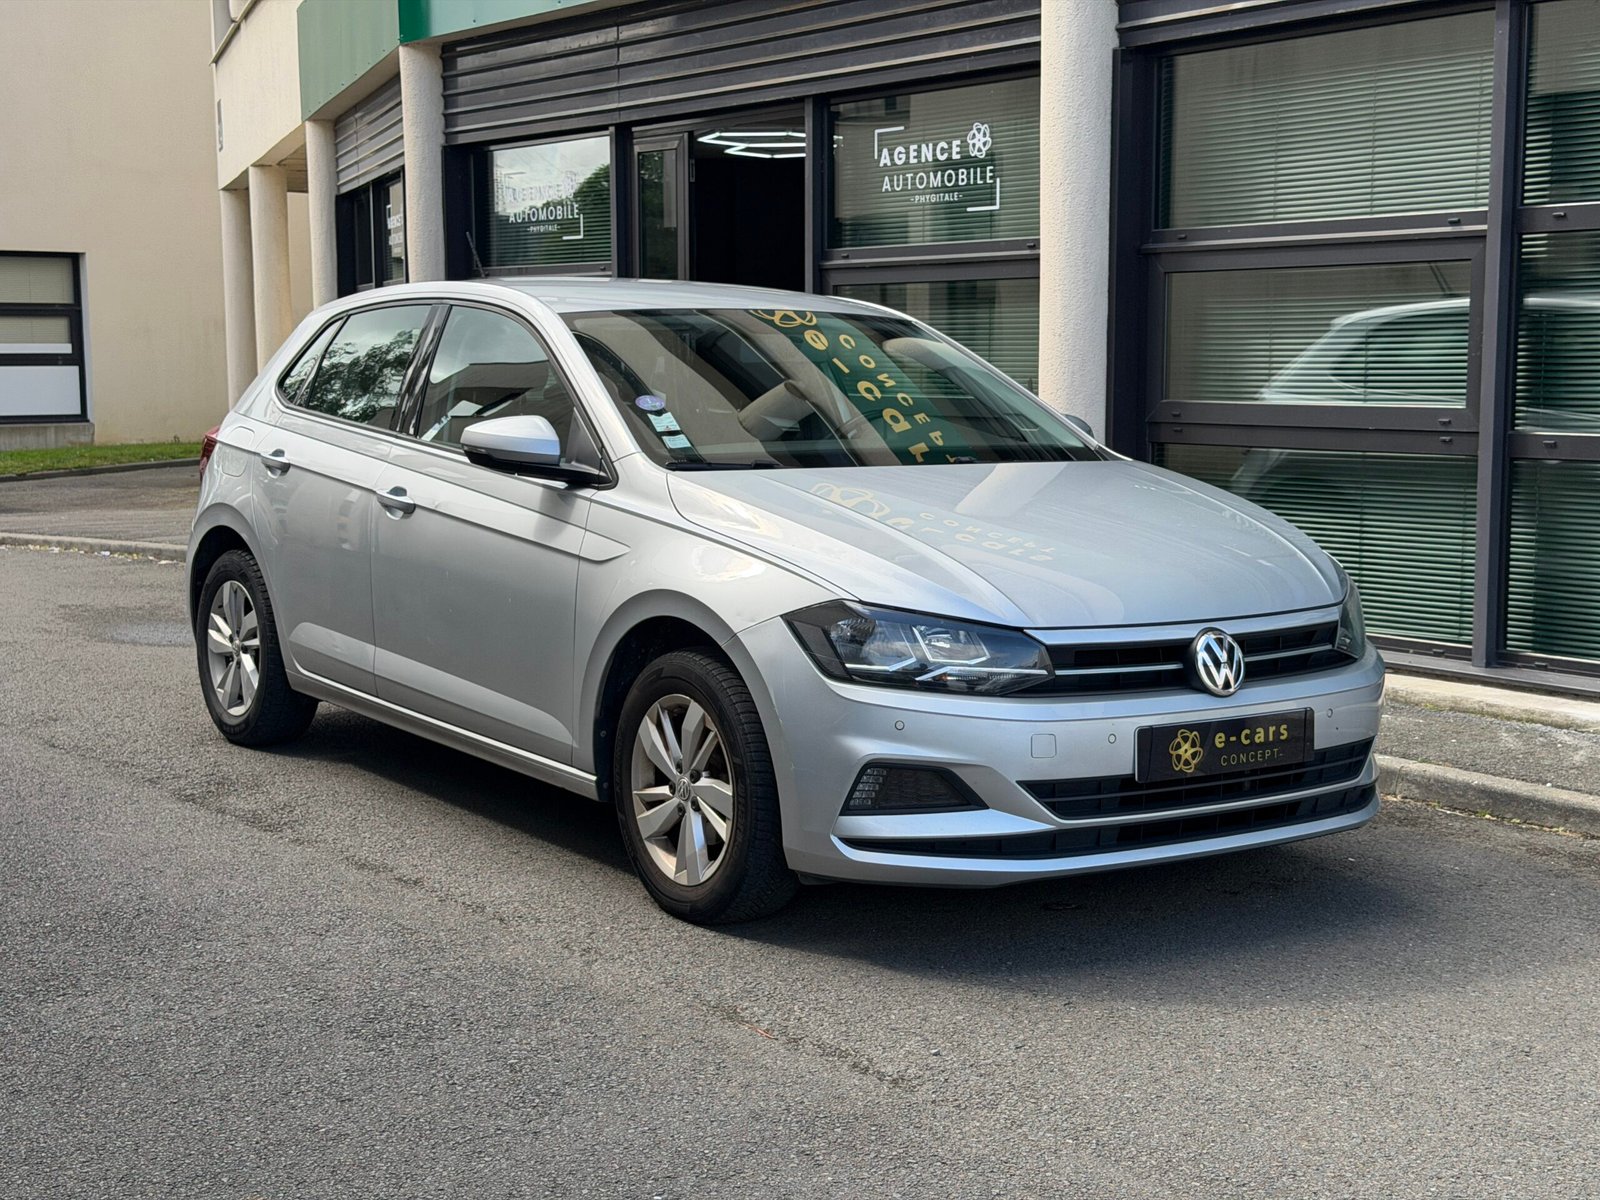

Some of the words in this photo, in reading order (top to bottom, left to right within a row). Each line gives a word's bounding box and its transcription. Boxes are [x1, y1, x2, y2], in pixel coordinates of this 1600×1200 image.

[879, 140, 961, 167] AGENCE
[882, 166, 994, 192] AUTOMOBILE
[509, 202, 580, 223] AUTOMOBILE
[1214, 724, 1288, 748] e-cars
